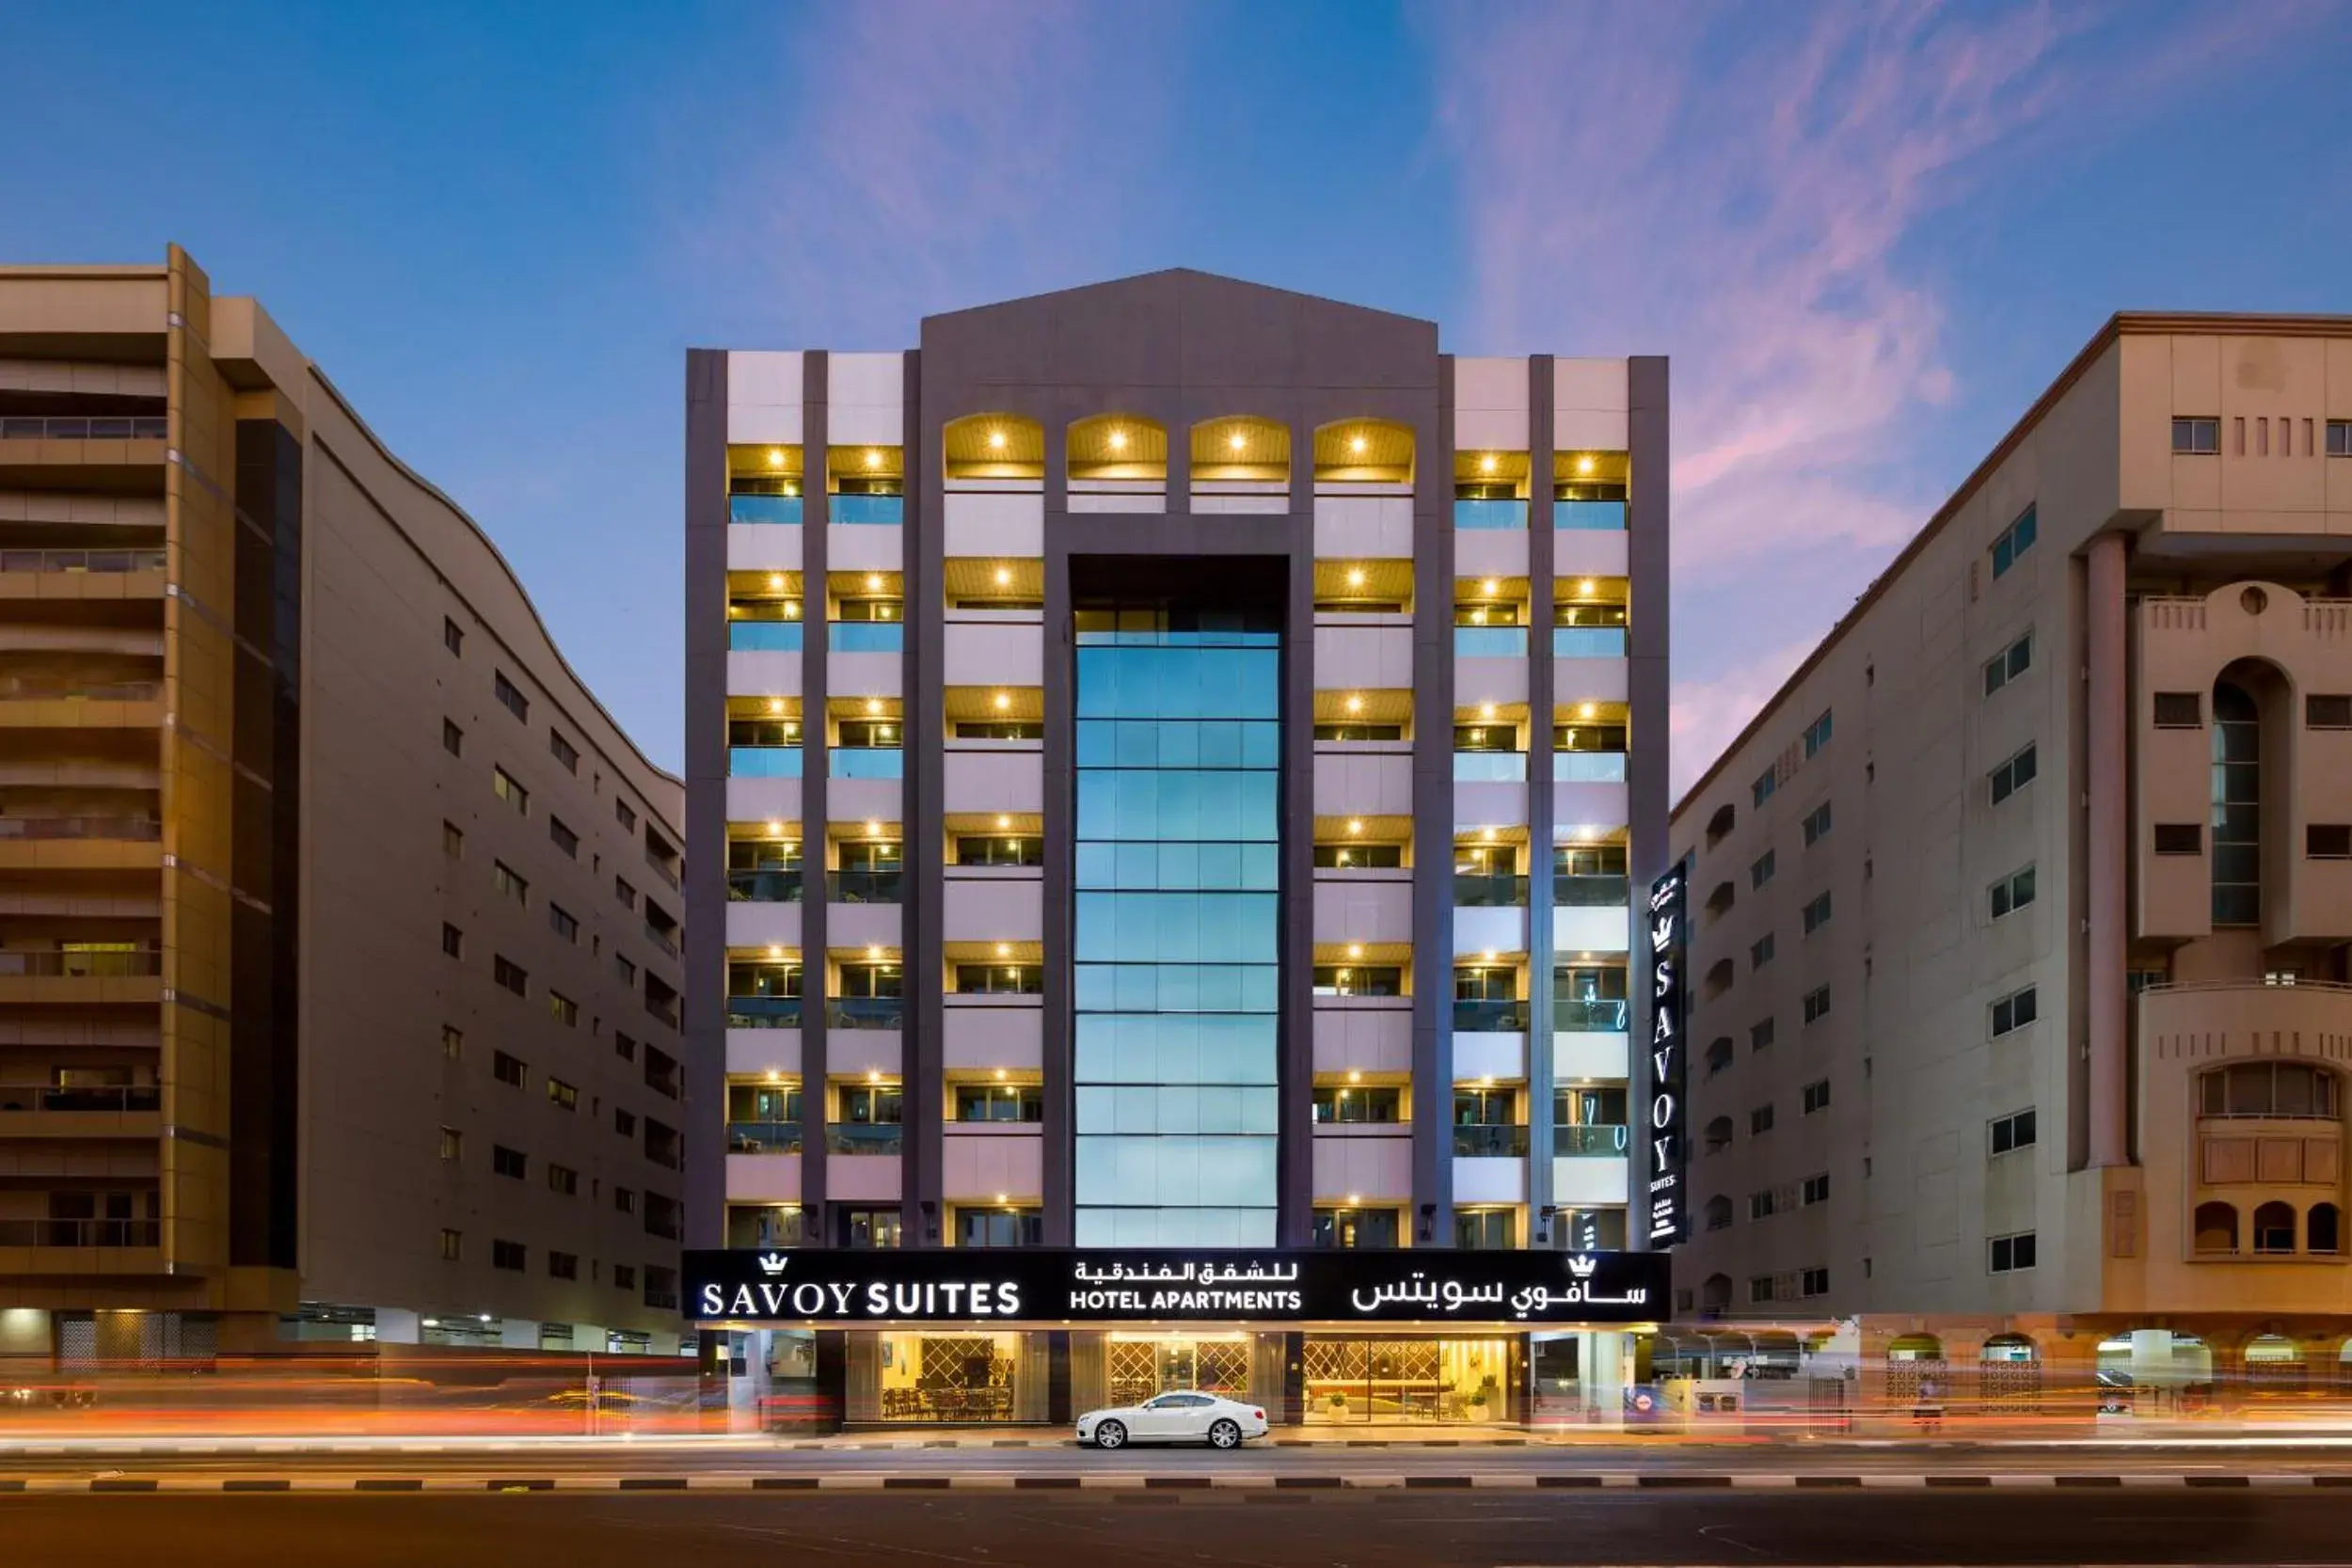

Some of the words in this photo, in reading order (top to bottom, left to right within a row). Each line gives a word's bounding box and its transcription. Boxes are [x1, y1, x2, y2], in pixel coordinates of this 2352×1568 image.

[1653, 960, 1674, 1173] SAVOY
[1074, 1261, 1195, 1286] الفندقية
[1198, 1261, 1298, 1286] للشقق
[702, 1282, 858, 1315] SAVOY
[866, 1281, 1021, 1315] SUITES
[1070, 1291, 1147, 1309] HOTEL
[1151, 1291, 1302, 1310] APARTMENTS
[1351, 1272, 1504, 1312] سويتس
[1509, 1279, 1647, 1319] سافوي
